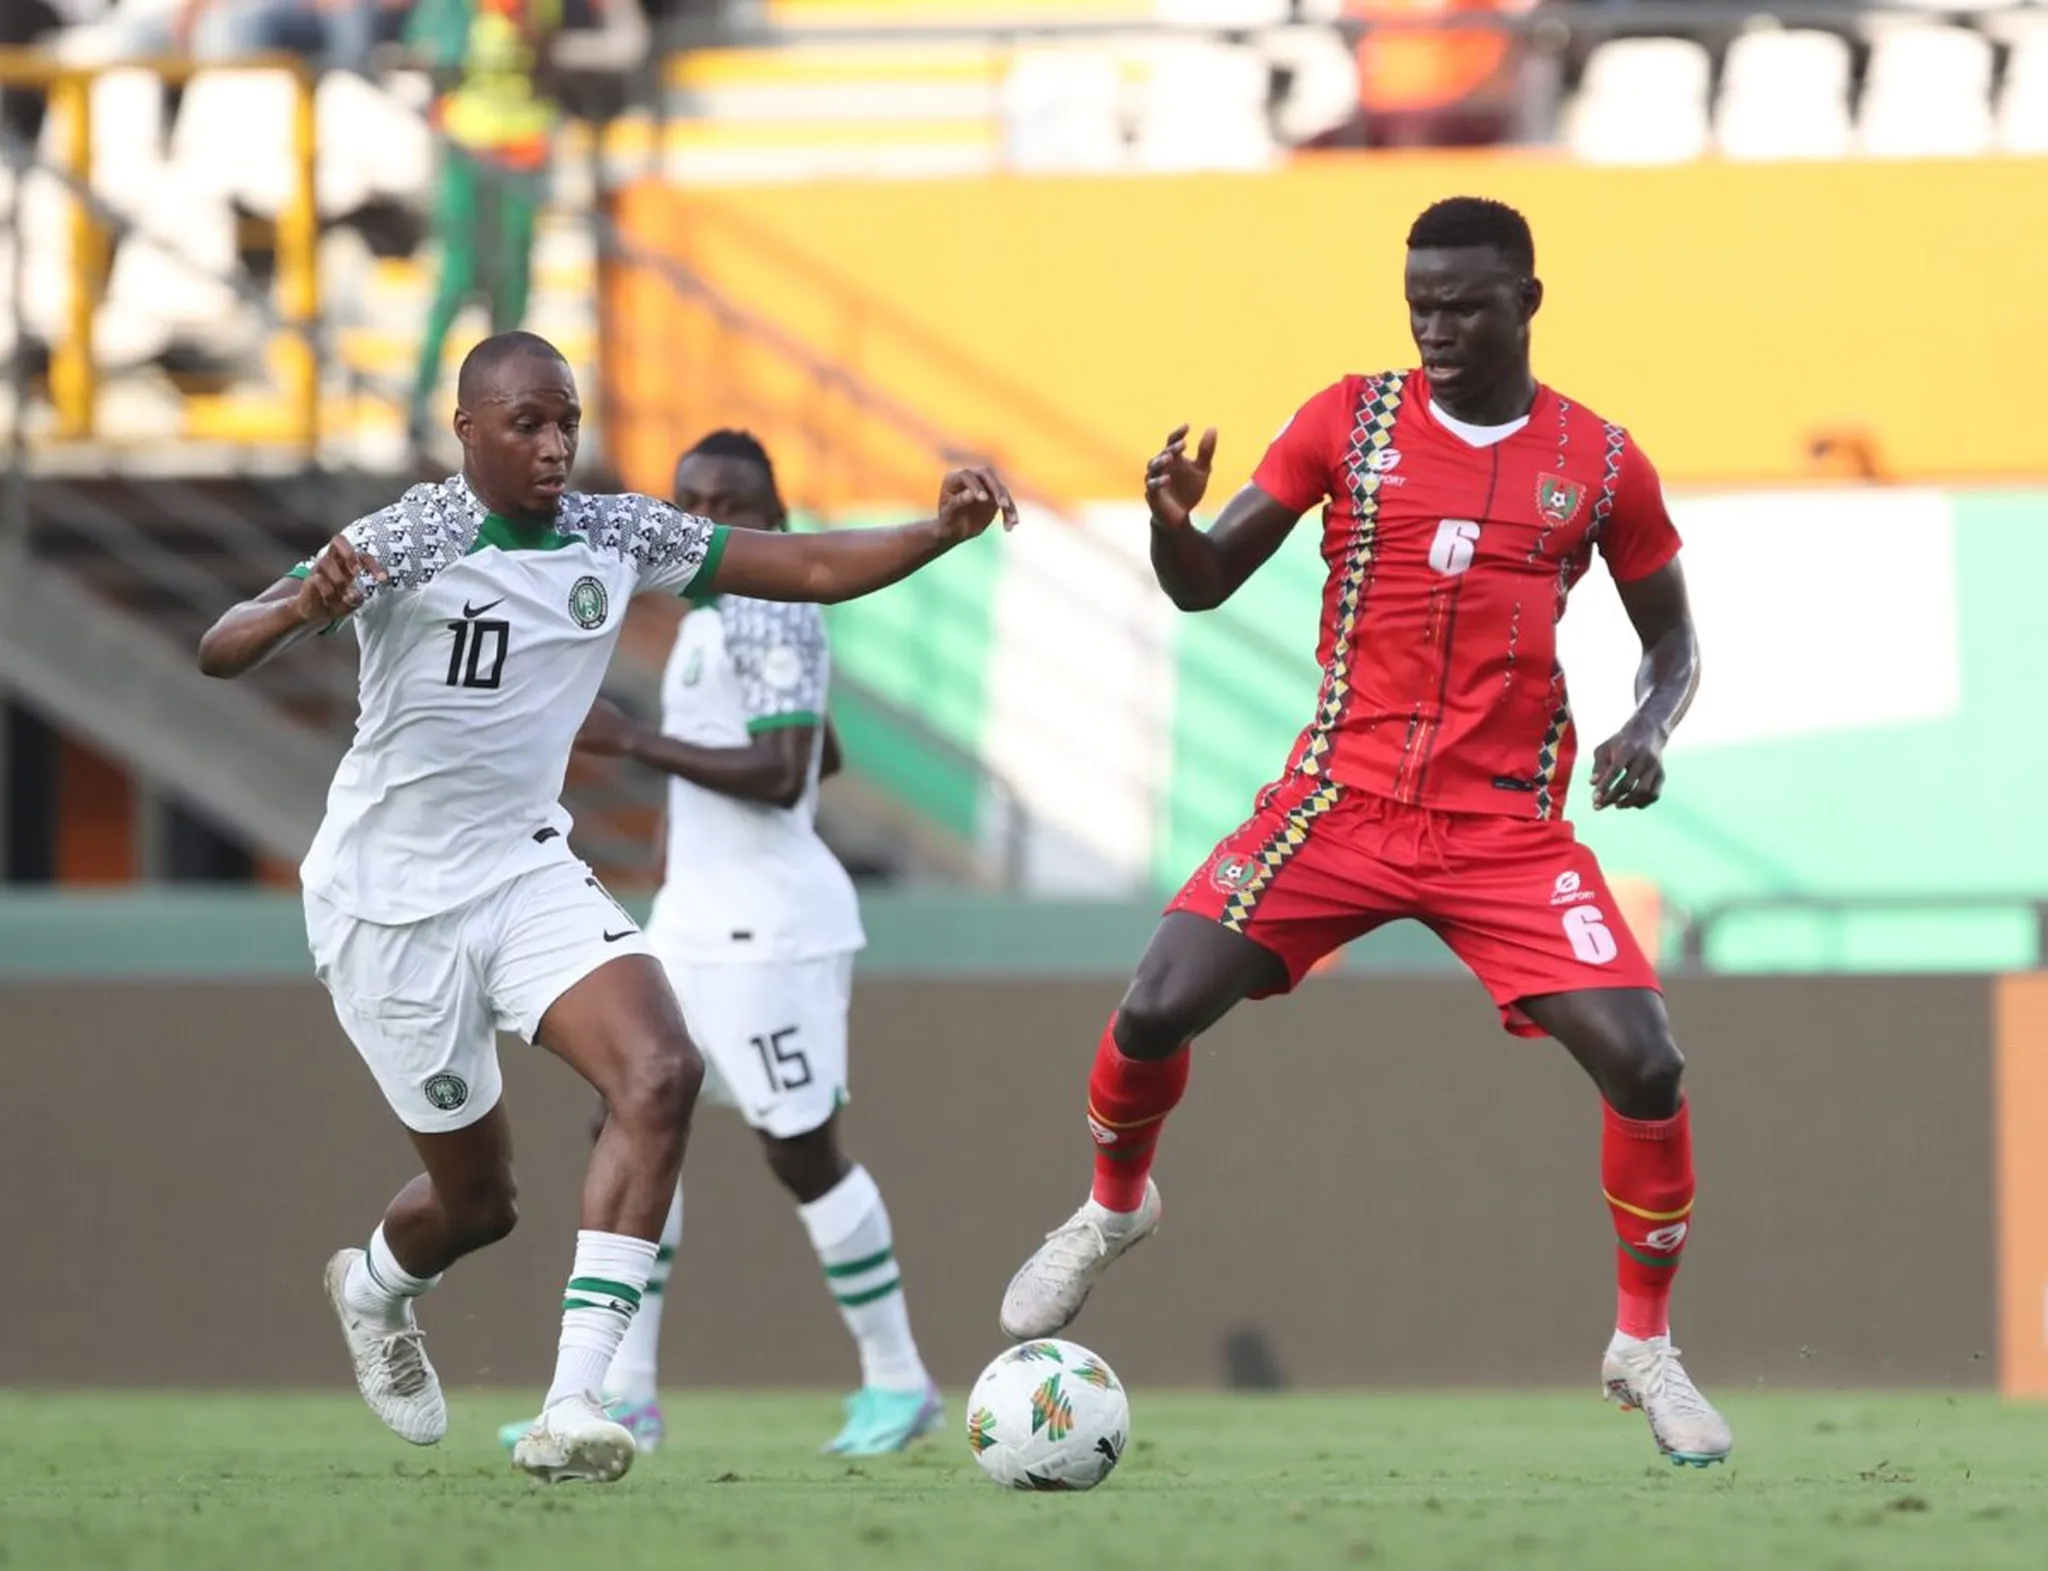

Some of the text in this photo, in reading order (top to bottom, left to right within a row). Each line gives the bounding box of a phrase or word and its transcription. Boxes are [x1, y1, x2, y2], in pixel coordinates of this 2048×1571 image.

[1428, 518, 1480, 577] 6
[446, 619, 510, 690] 10
[1561, 904, 1618, 965] 6
[749, 1026, 813, 1094] 15
